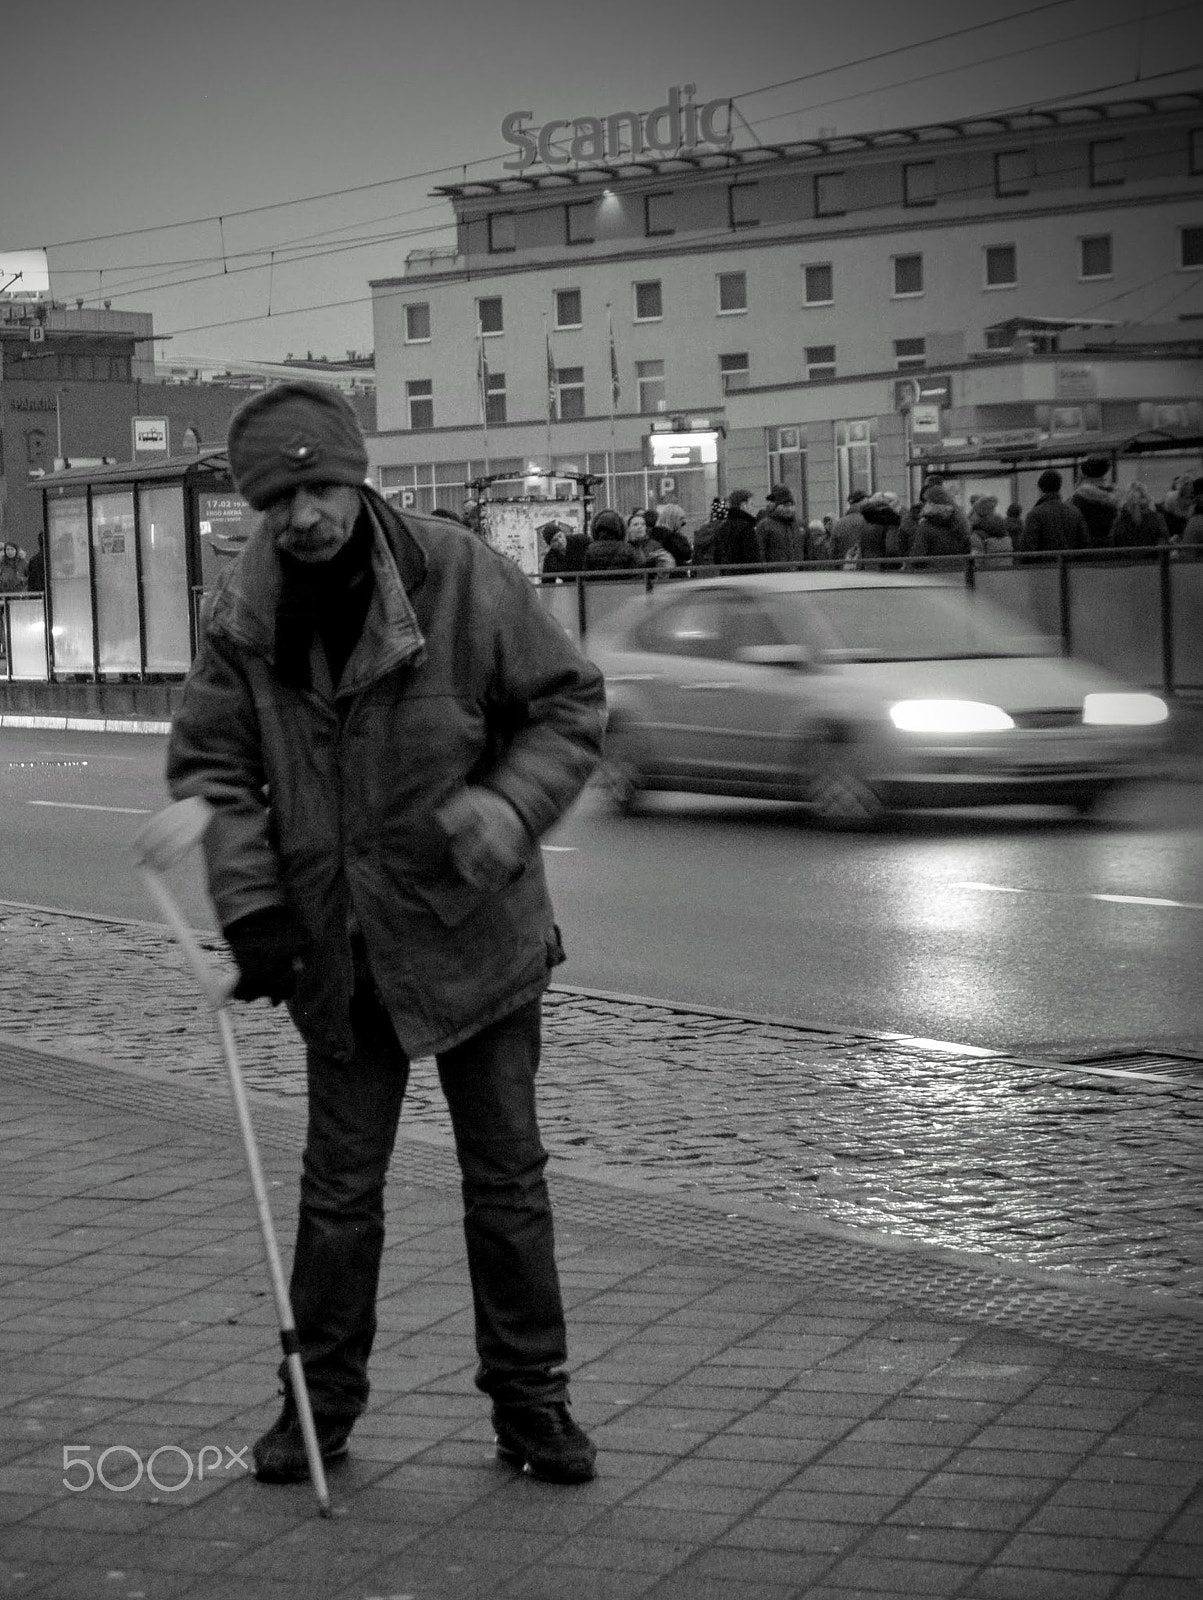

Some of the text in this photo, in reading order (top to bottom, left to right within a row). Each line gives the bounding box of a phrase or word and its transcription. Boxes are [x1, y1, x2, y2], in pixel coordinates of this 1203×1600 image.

[501, 83, 734, 169] Scandic
[661, 478, 675, 496] P
[402, 492, 413, 509] P
